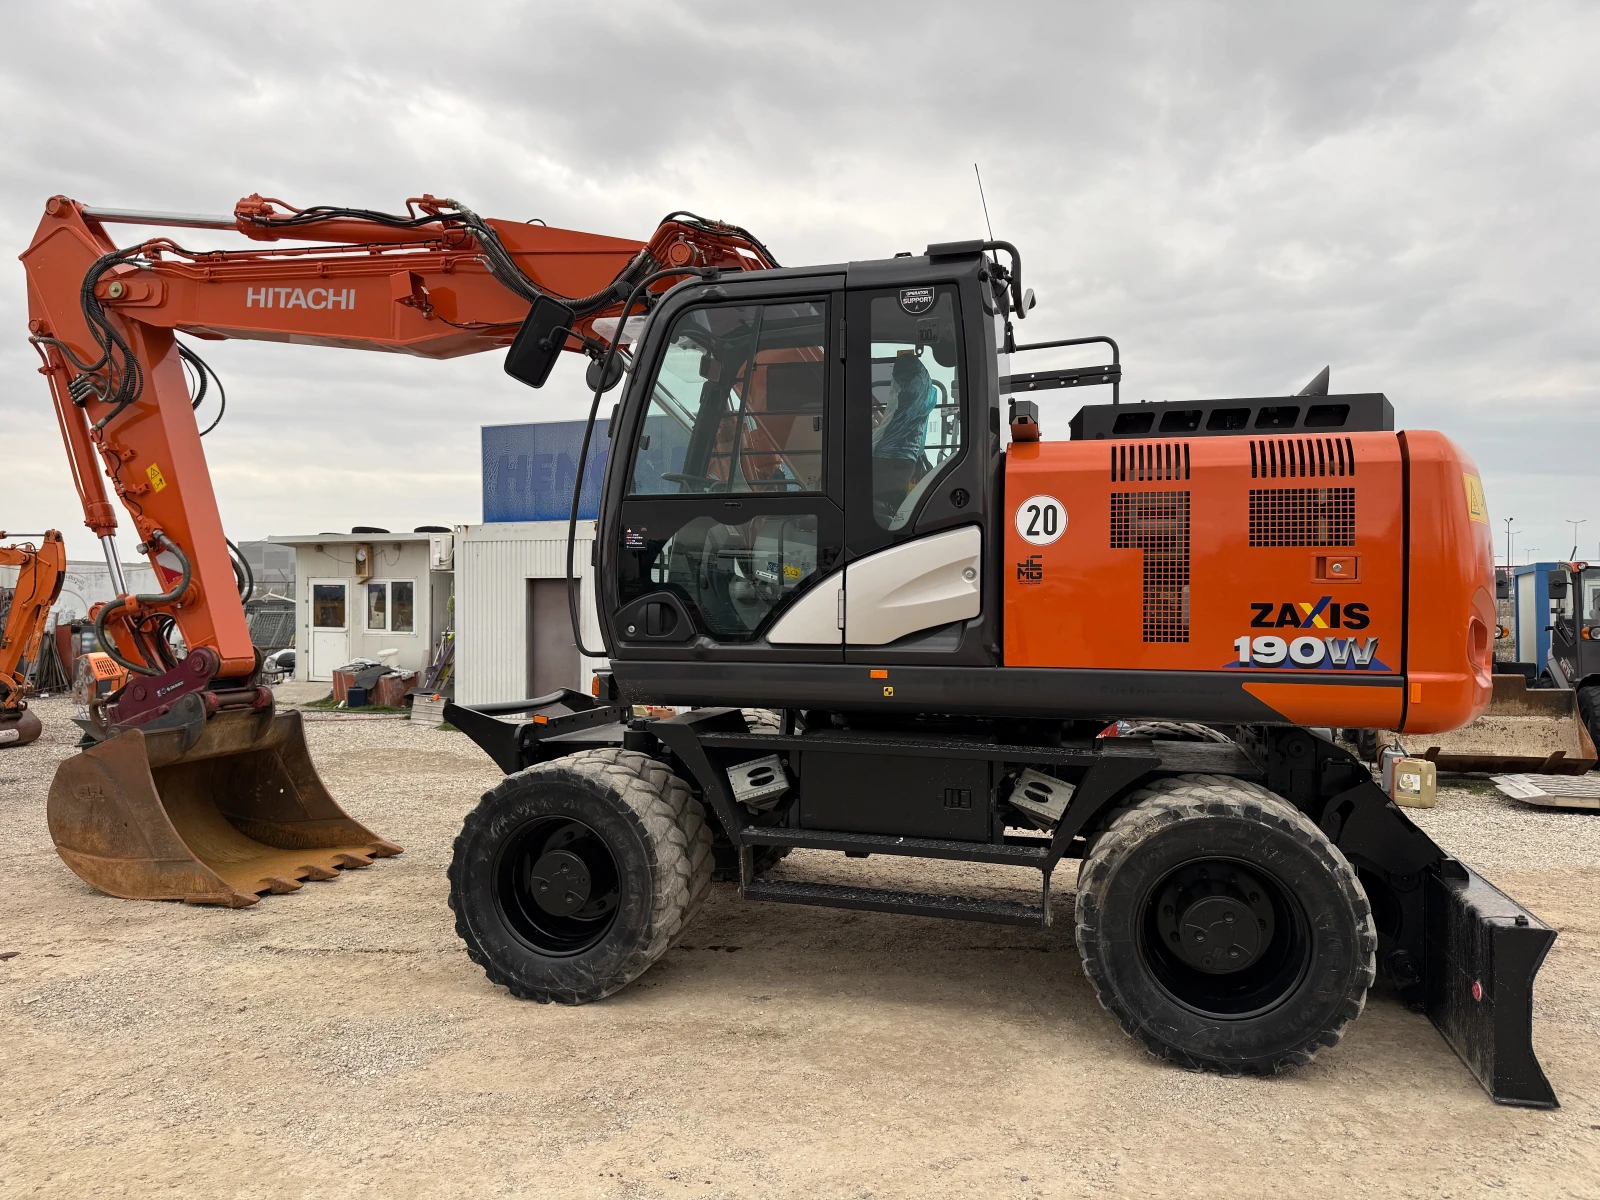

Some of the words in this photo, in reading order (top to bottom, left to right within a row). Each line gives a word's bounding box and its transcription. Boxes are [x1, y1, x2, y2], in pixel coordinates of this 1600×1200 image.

[246, 287, 356, 310] HITACHI
[902, 296, 932, 304] SUPPORT
[1026, 504, 1058, 536] 20
[1250, 596, 1370, 630] ZAXIS
[1234, 635, 1379, 668] 190W
